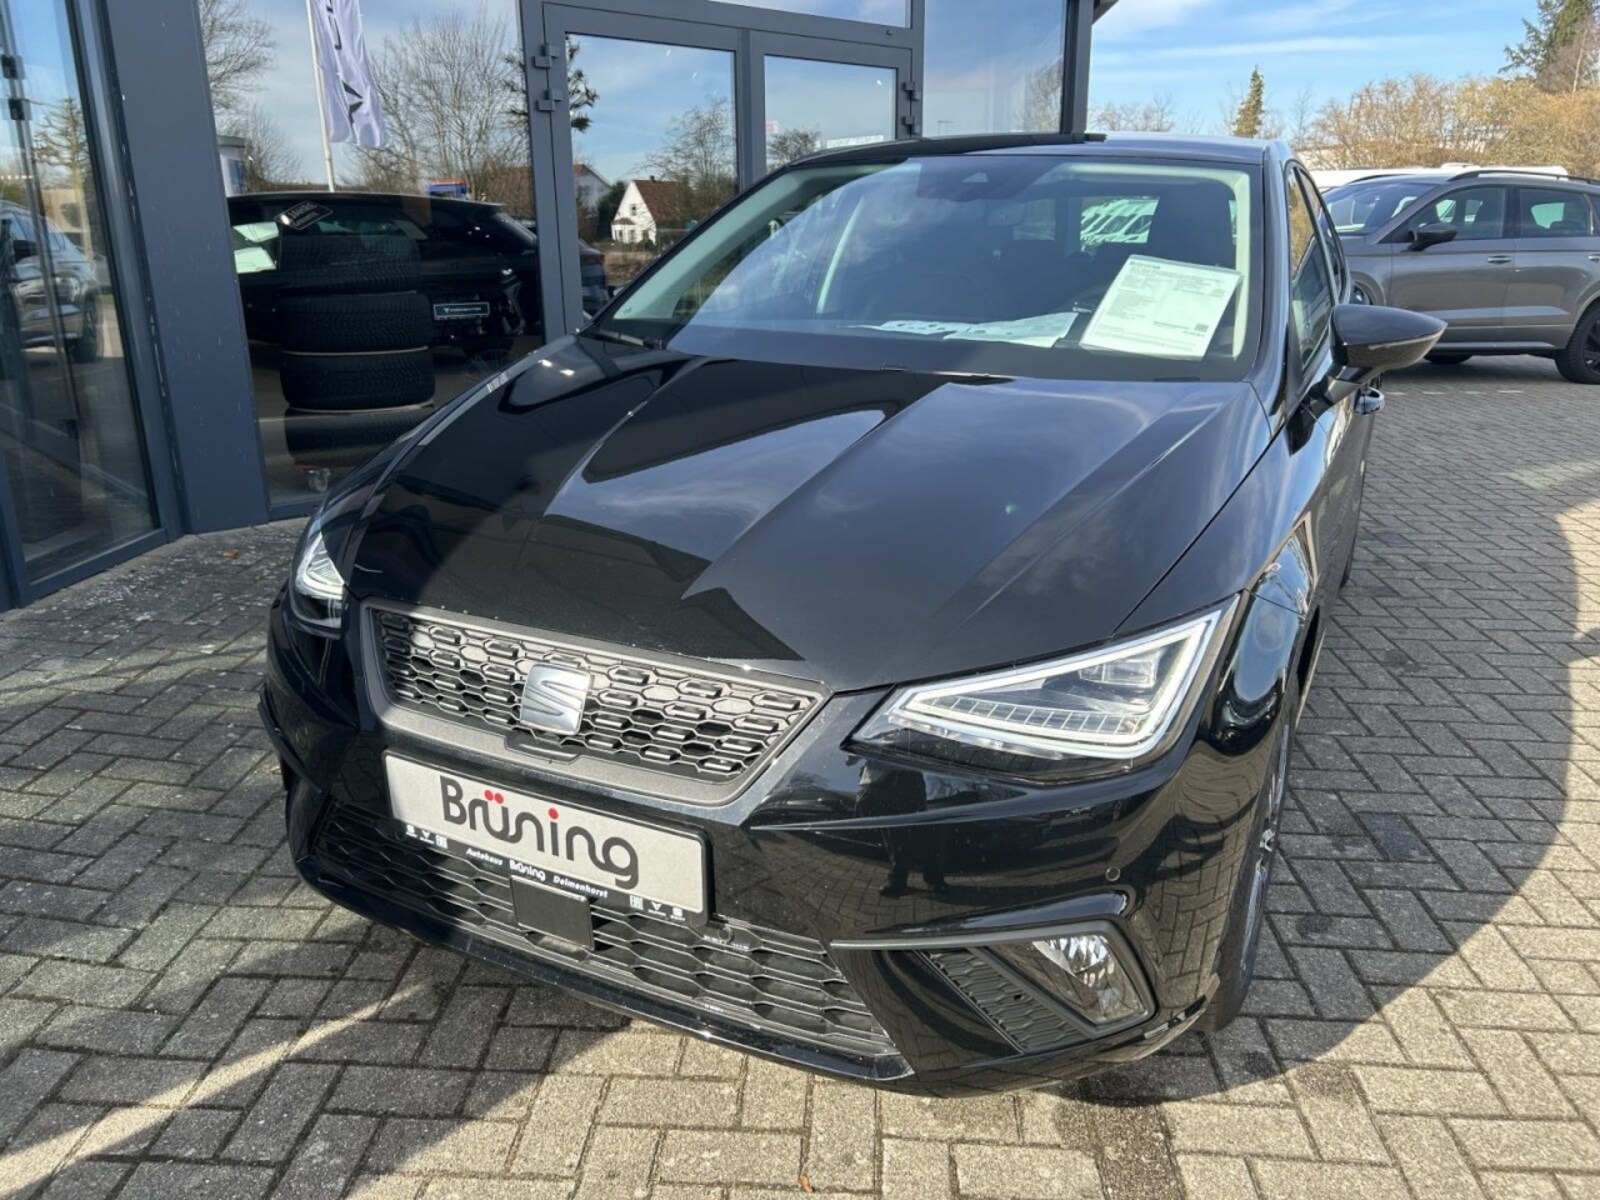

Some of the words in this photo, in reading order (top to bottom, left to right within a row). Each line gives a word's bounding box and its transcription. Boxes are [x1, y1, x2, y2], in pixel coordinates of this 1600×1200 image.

[439, 775, 639, 890] Brüning
[466, 847, 504, 866] Autohaus
[509, 859, 546, 882] Brüning
